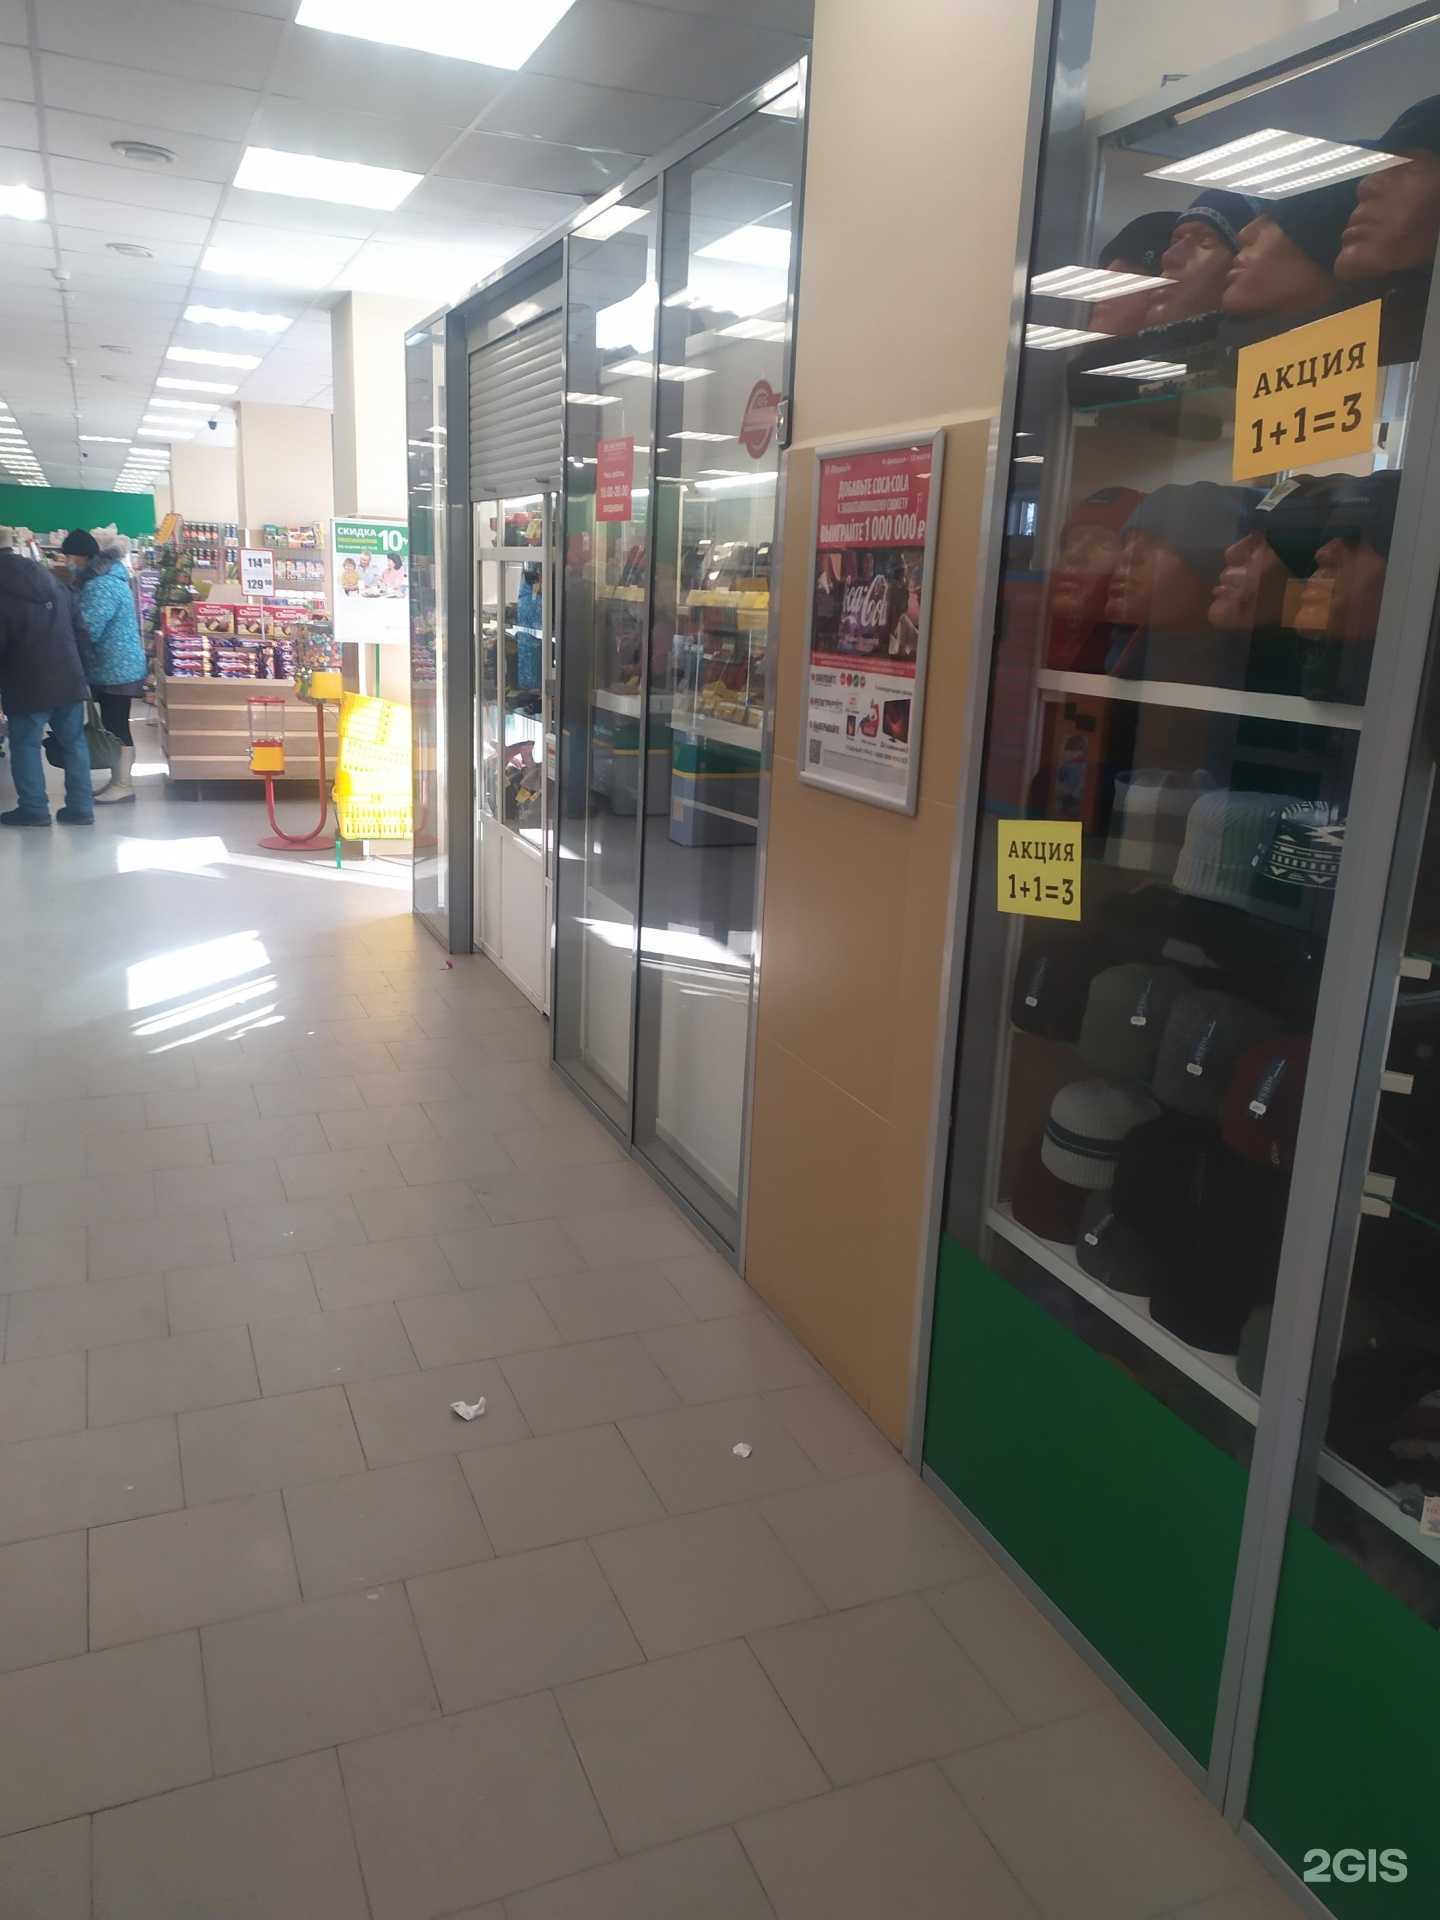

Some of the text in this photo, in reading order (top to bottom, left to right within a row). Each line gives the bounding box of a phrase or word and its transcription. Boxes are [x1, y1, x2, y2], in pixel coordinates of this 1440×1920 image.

[1252, 341, 1367, 399] АКЦИЯ
[1251, 391, 1362, 454] 1+1=3
[337, 527, 377, 538] СКИДКА
[1007, 840, 1075, 864] АКЦИЯ
[1008, 873, 1075, 906] 1+1=3
